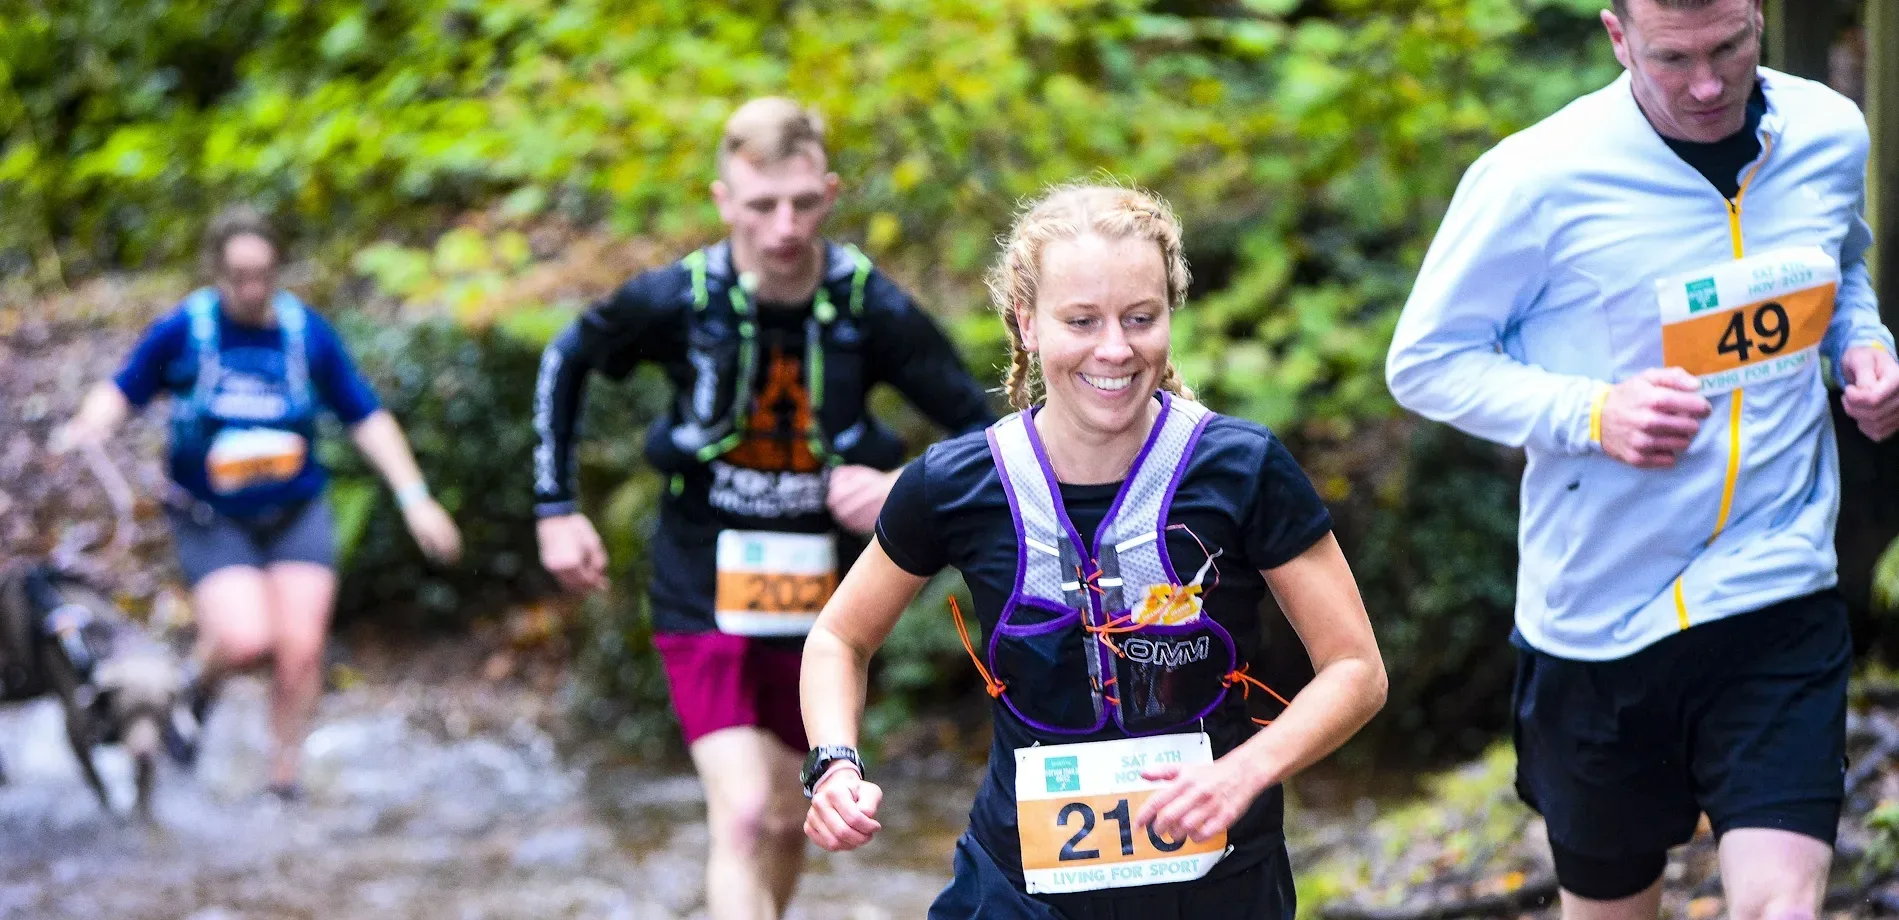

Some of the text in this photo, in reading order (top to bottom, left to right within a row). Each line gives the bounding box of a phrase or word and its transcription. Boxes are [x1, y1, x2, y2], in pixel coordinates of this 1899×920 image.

[1717, 302, 1790, 361] 49
[1700, 352, 1810, 389] IVING FOR SPORT
[1124, 636, 1209, 667] OMM
[1121, 750, 1182, 768] SAT 4TH
[1053, 859, 1200, 886] LIVING FOR SPORT
